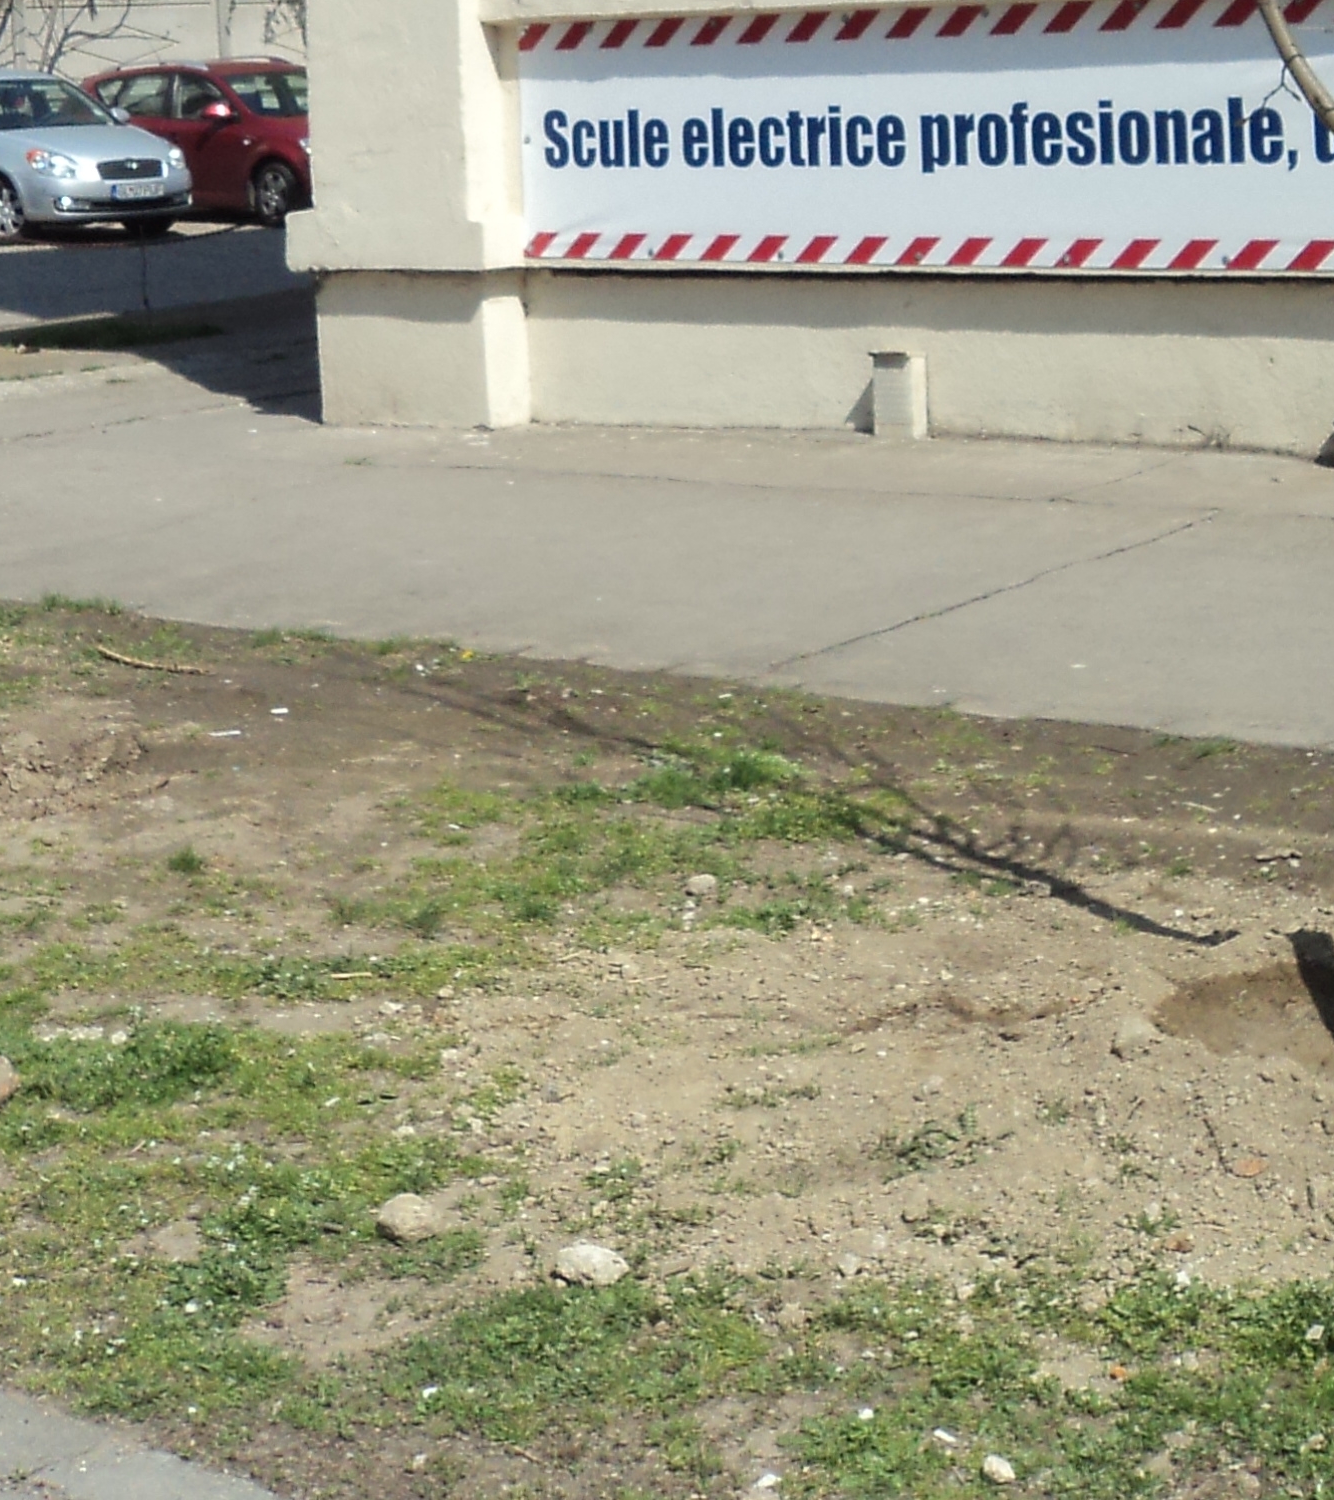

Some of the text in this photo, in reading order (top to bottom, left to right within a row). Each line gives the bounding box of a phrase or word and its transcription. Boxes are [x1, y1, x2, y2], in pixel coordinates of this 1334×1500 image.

[543, 109, 669, 169] Scule
[682, 105, 907, 169] electrice
[920, 97, 1299, 173] profesionale,
